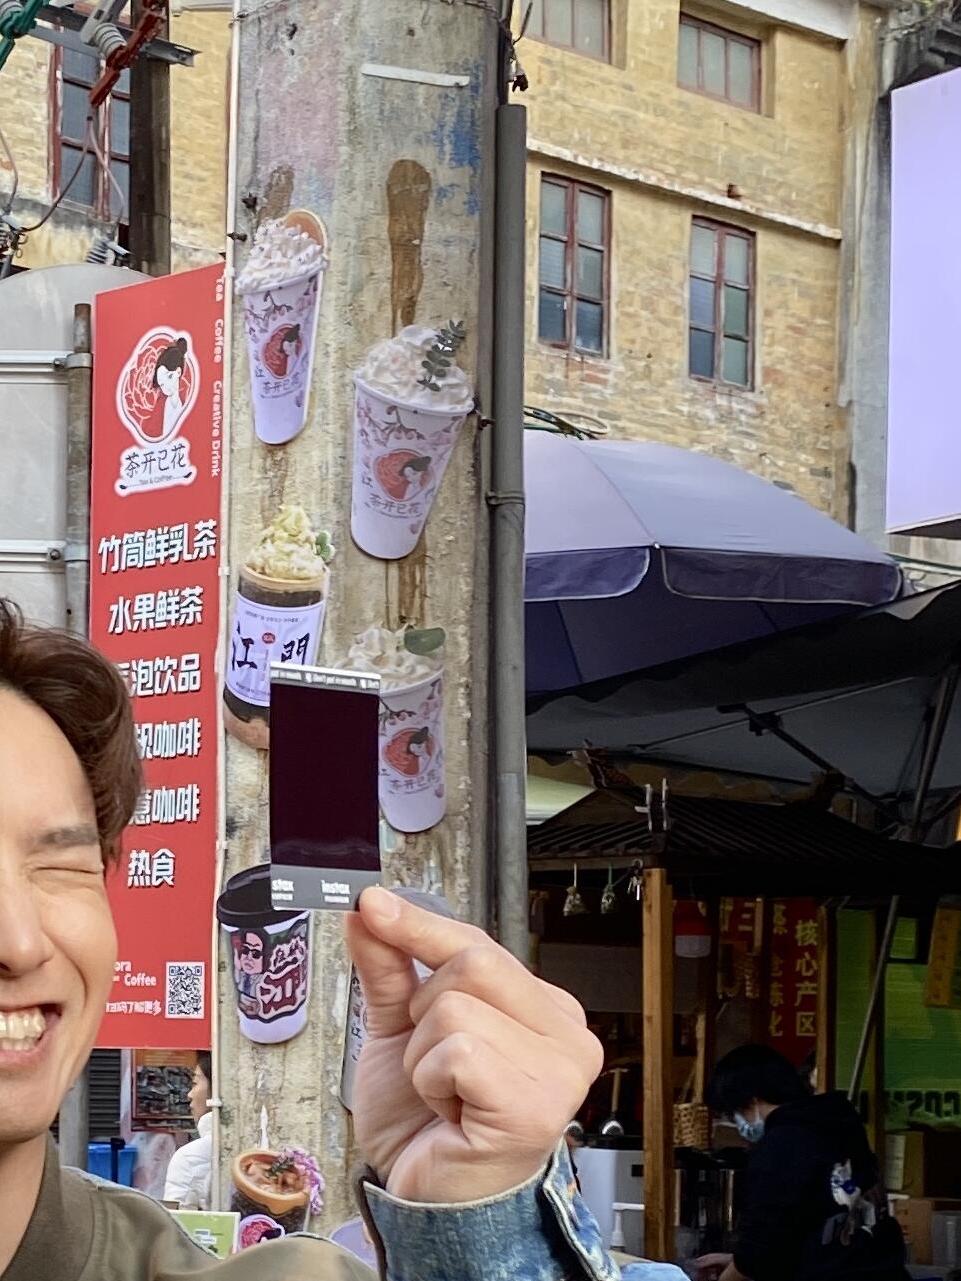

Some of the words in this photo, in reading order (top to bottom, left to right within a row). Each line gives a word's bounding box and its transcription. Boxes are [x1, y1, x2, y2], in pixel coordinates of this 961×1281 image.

[213, 318, 224, 364] Coffee
[211, 381, 223, 437] Creative
[210, 440, 222, 478] Drink
[98, 519, 217, 574] 竹筒鲜乳茶
[107, 585, 204, 635] 水果鲜茶
[127, 847, 176, 888] 热食
[124, 972, 157, 987] Coffee
[795, 919, 819, 1037] 核心产区
